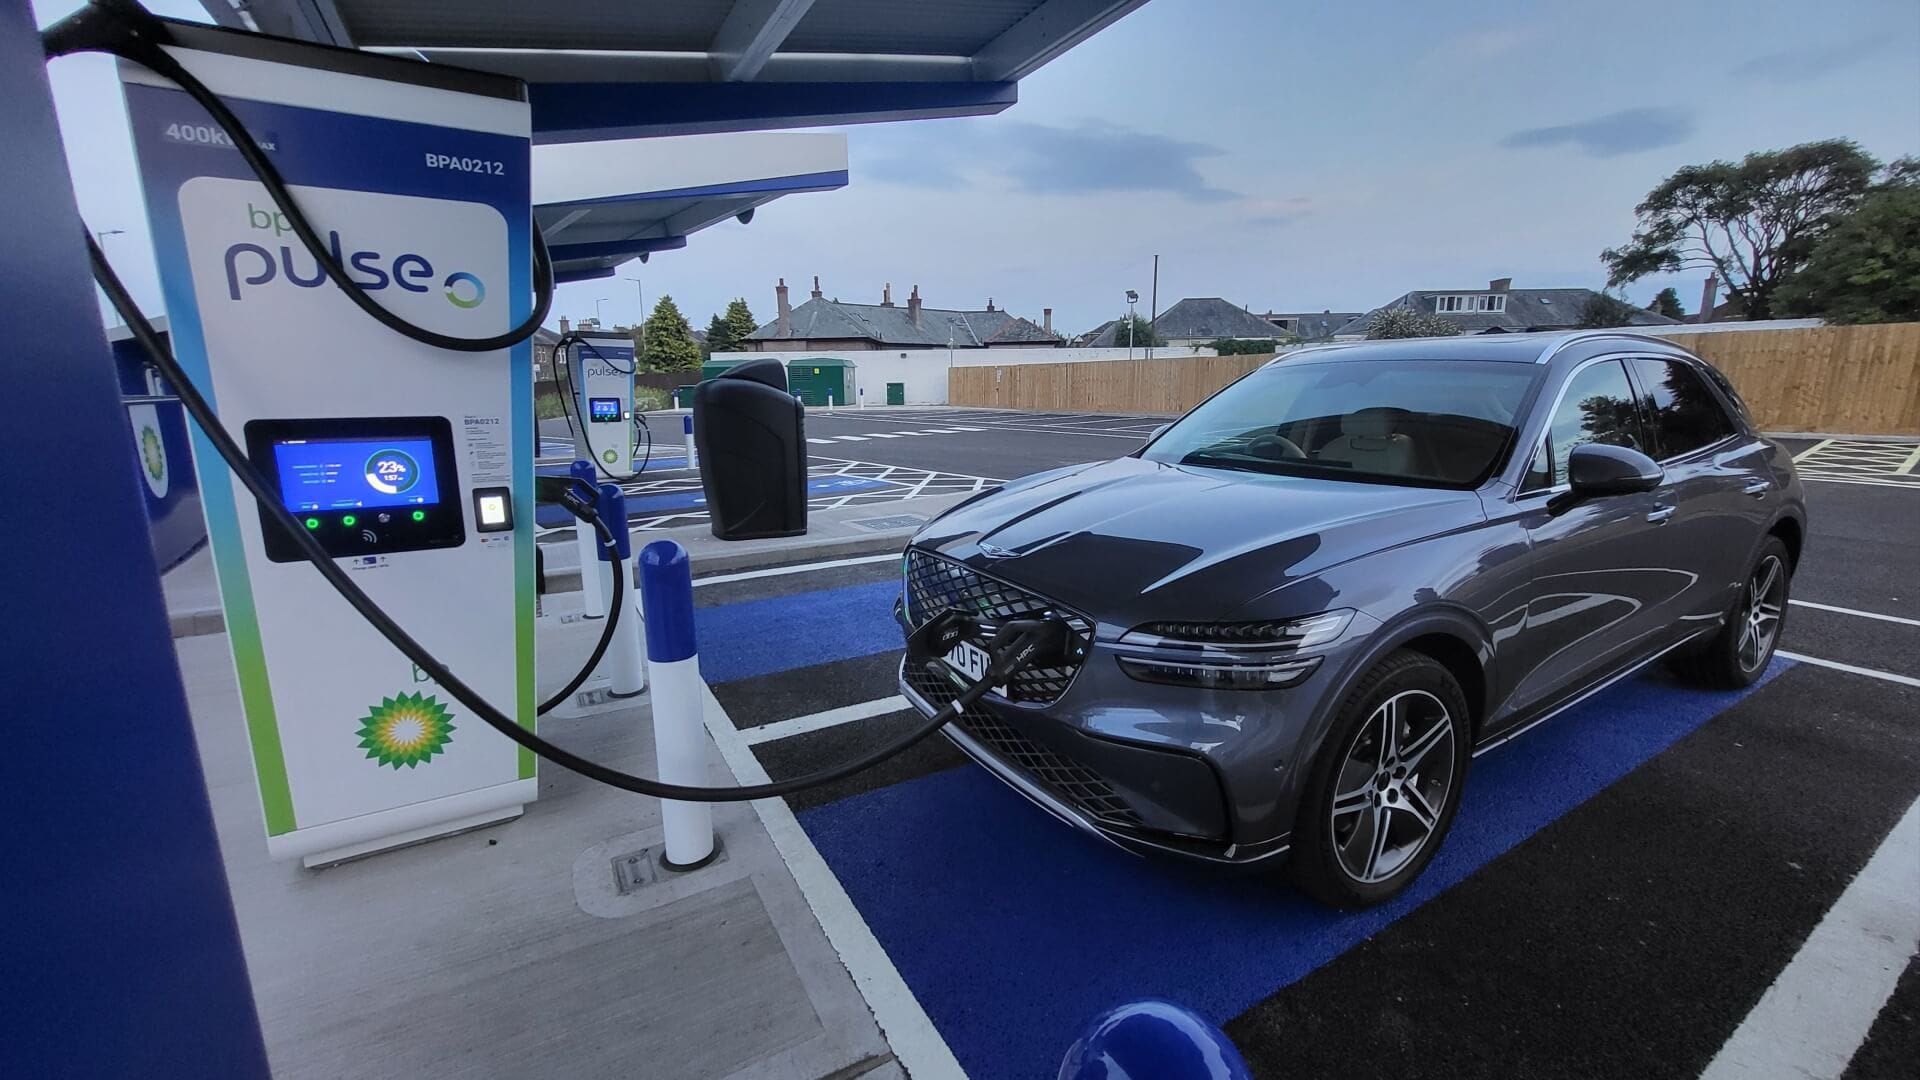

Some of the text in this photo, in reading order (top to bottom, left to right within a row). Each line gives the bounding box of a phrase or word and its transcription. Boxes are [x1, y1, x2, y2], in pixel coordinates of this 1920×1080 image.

[258, 142, 277, 151] AX
[425, 152, 505, 176] BPA0212
[224, 230, 434, 300] pulse
[587, 366, 619, 378] pulse
[1015, 643, 1036, 662] HPC
